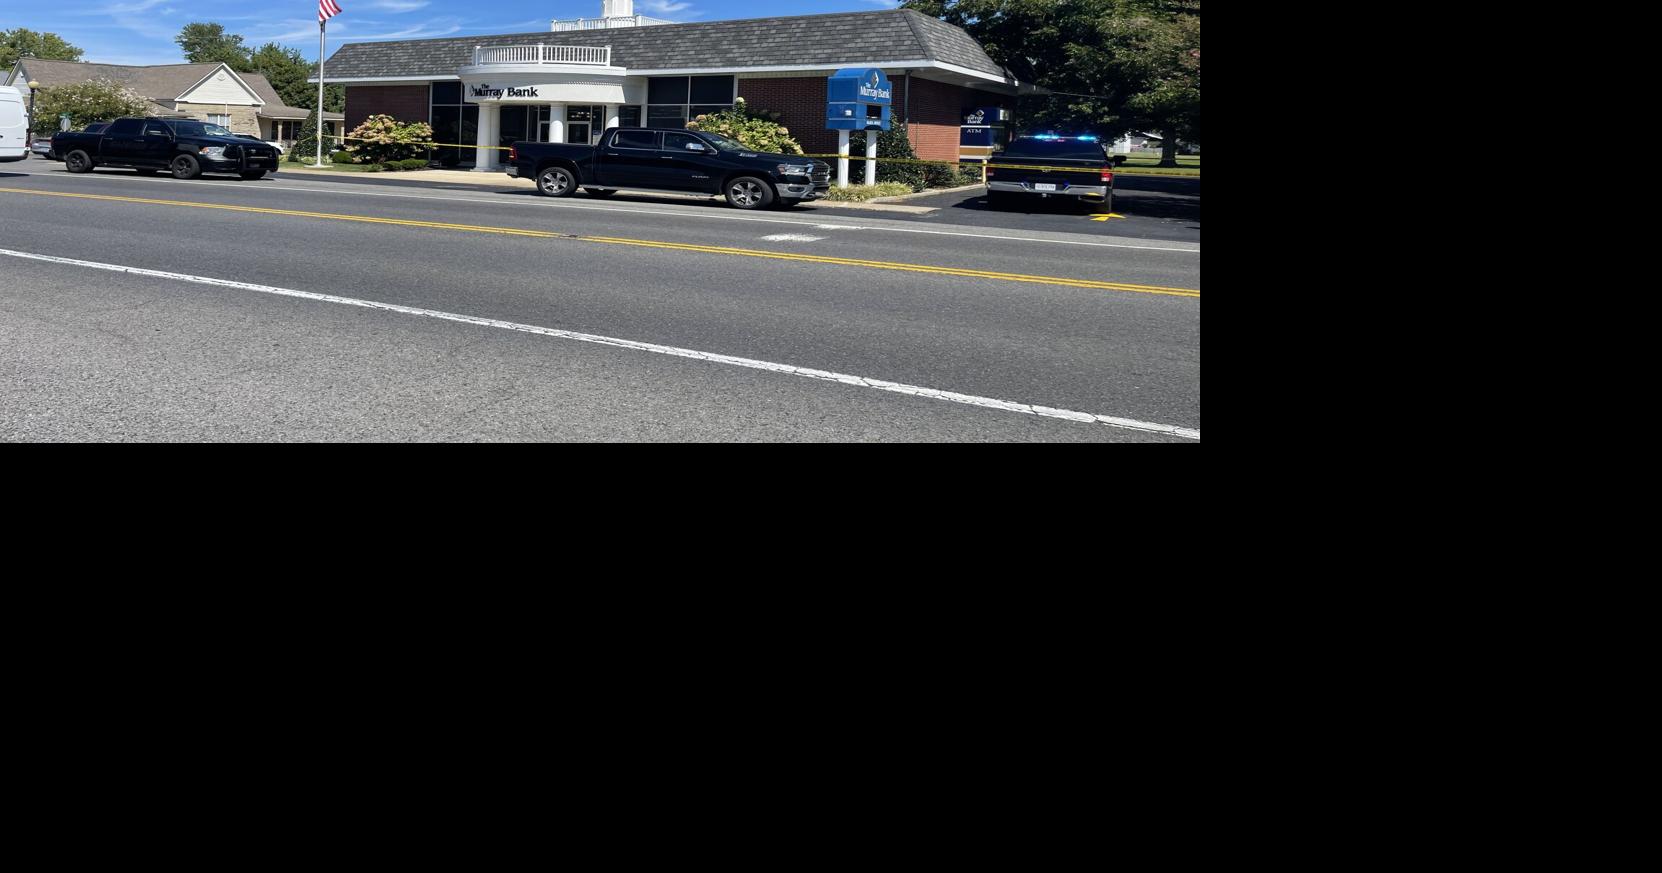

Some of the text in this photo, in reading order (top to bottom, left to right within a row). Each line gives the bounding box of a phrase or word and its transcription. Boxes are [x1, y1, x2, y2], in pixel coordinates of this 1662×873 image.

[474, 86, 539, 100] Murray Bank
[860, 86, 890, 100] Murray Bank
